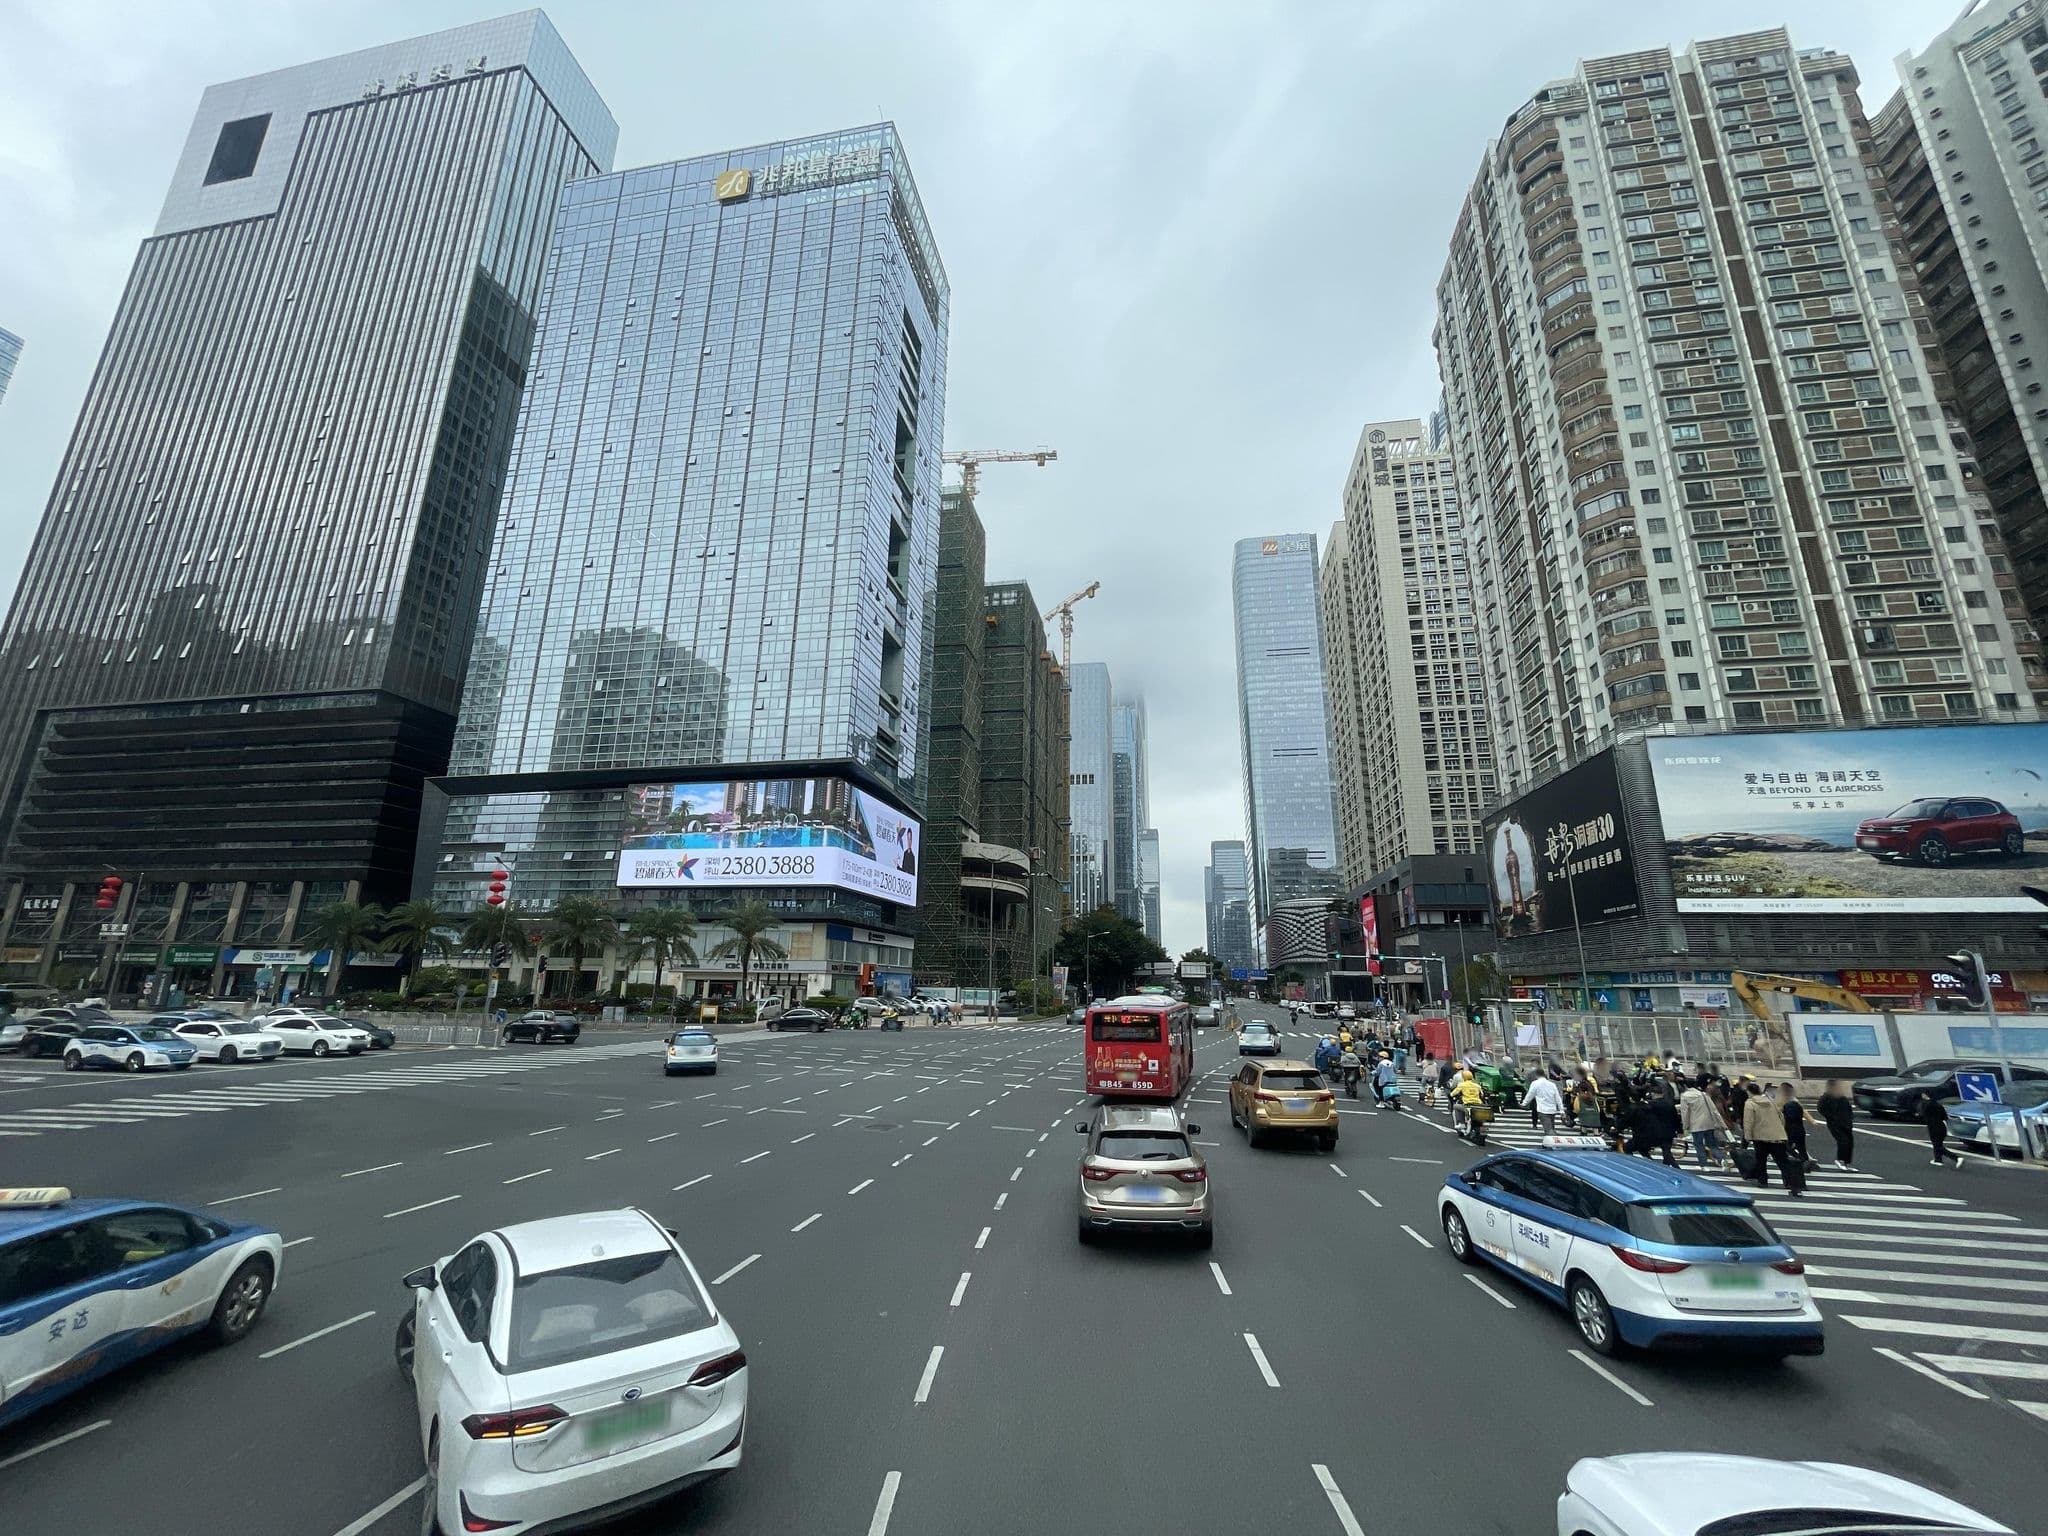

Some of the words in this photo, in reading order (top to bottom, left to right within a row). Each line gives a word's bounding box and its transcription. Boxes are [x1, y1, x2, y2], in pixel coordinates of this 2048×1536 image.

[755, 148, 879, 186] 兆邦基金融
[1744, 772, 1808, 785] 爱与自由
[1815, 770, 1881, 783] 海阔天空
[1769, 786, 1811, 794] BEYOND
[1820, 785, 1832, 793] C5
[1835, 784, 1883, 793] AIRCROSS
[1792, 801, 1844, 809] 乐享上市
[705, 857, 720, 865] 深圳
[722, 856, 766, 875] 2380
[769, 855, 814, 875] 3888
[635, 867, 676, 879] 碧湖春天
[704, 867, 719, 876] 坪山
[1725, 874, 1745, 882] SUV
[1861, 972, 1919, 983] 图文广告
[1578, 1137, 1601, 1145] TAXI
[13, 1190, 48, 1201] TAXI
